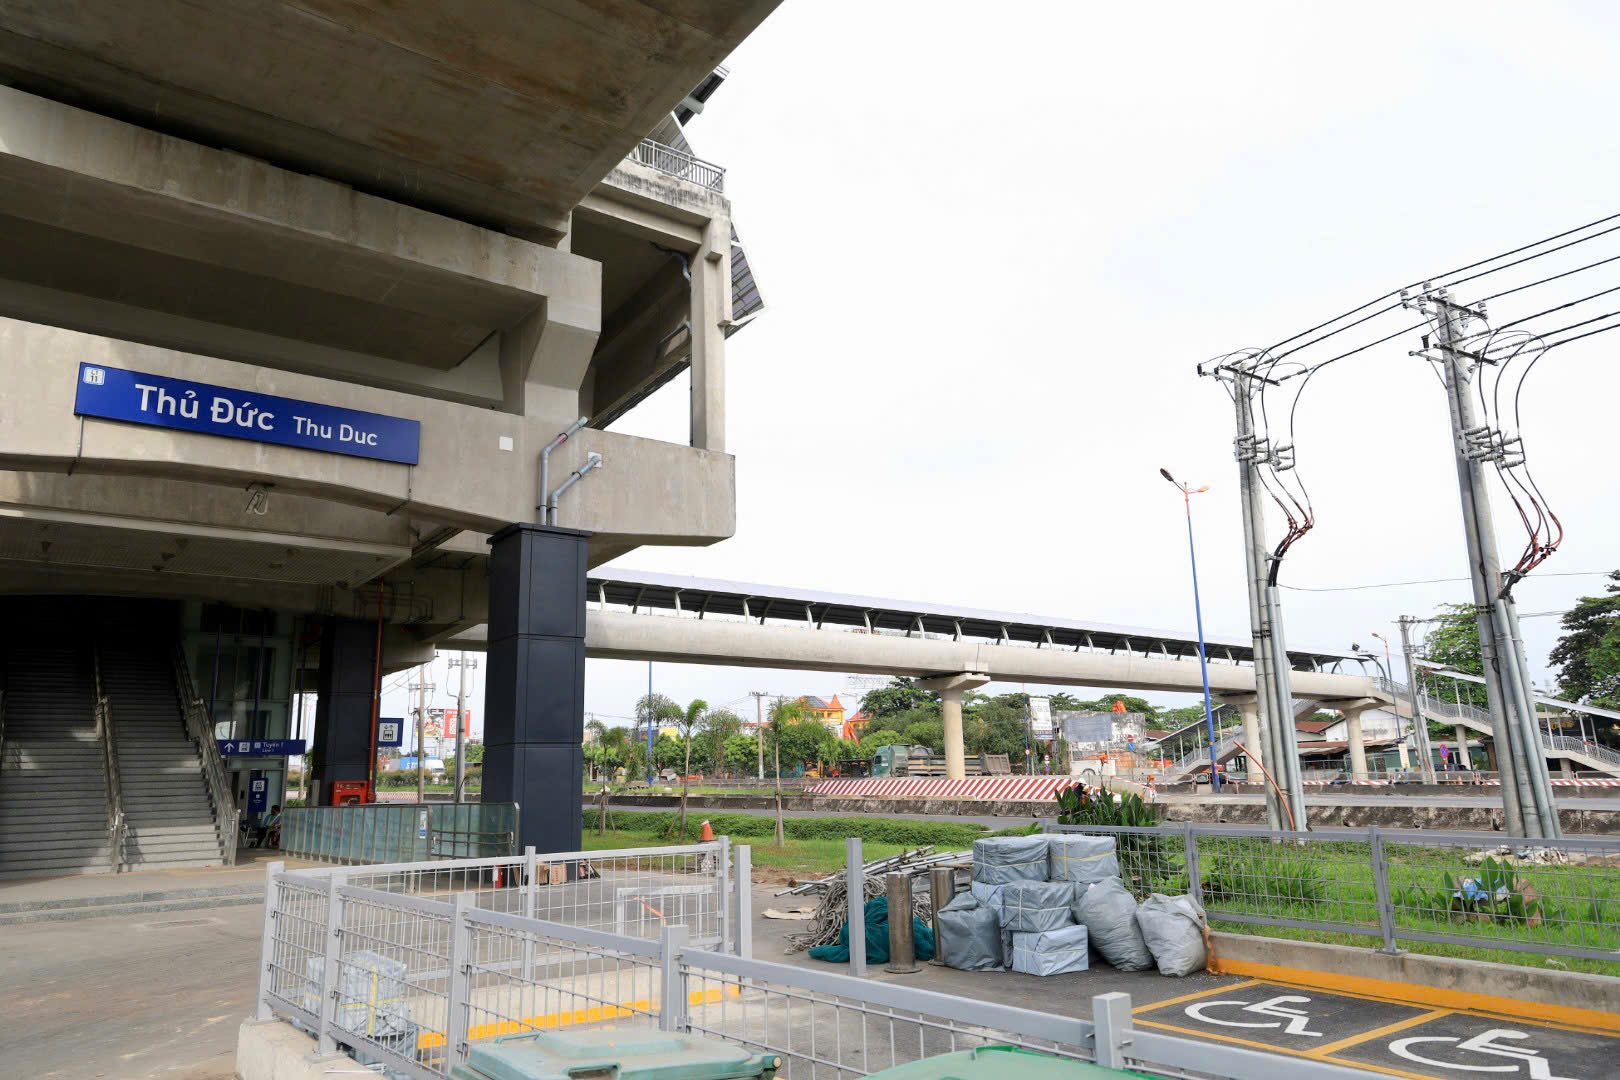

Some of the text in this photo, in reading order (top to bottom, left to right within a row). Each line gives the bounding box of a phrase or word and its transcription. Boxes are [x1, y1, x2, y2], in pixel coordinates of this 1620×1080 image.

[135, 383, 275, 431] Thủ Đức
[293, 416, 378, 446] Thu Duc
